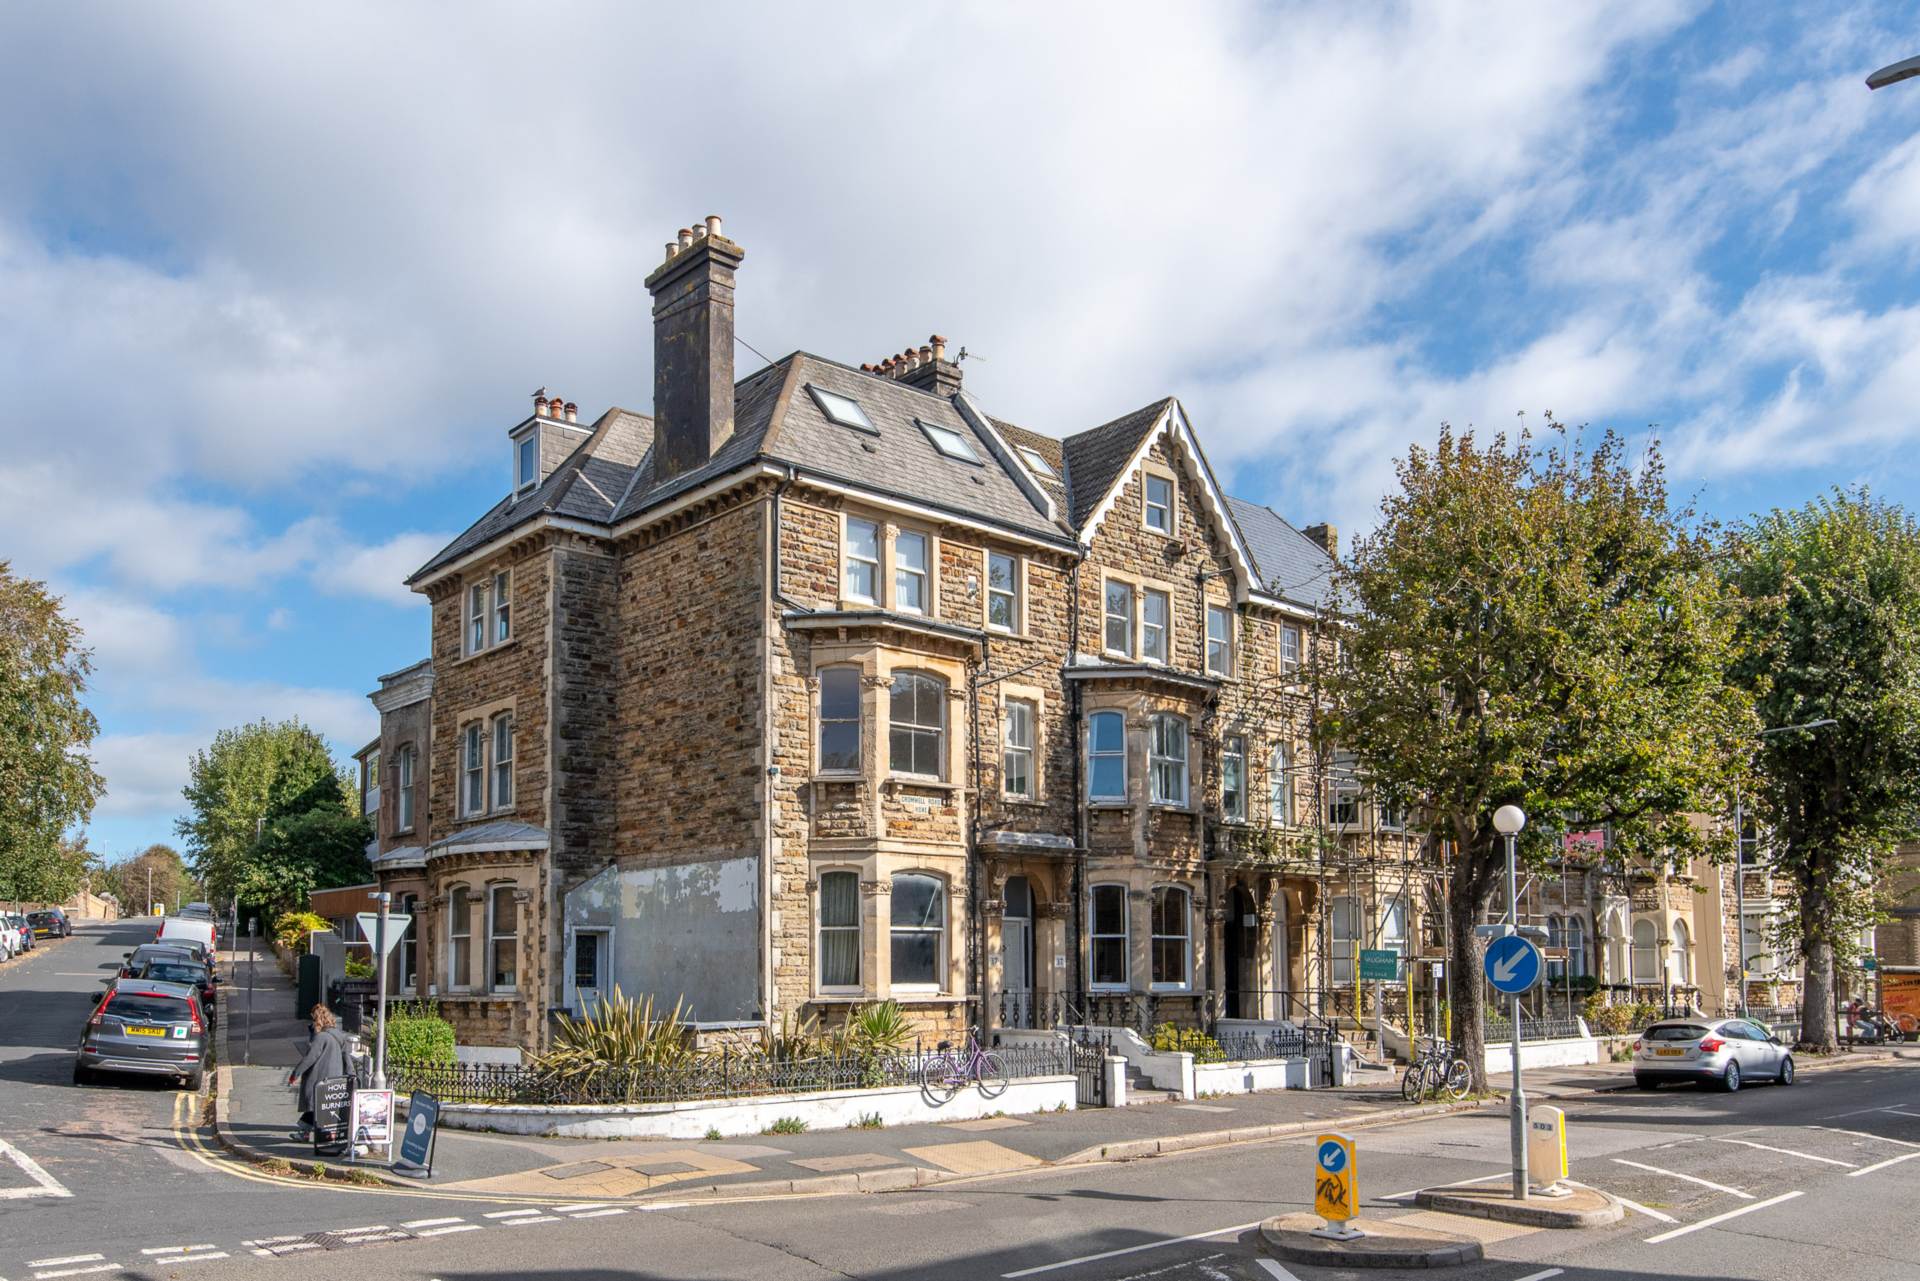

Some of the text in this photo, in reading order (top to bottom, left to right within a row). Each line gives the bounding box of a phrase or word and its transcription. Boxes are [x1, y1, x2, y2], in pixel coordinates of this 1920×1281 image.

[901, 796, 925, 804] CROMWELL
[327, 1083, 347, 1092] HOVE
[324, 1091, 350, 1101] WOOD
[321, 1100, 352, 1111] BURNERS
